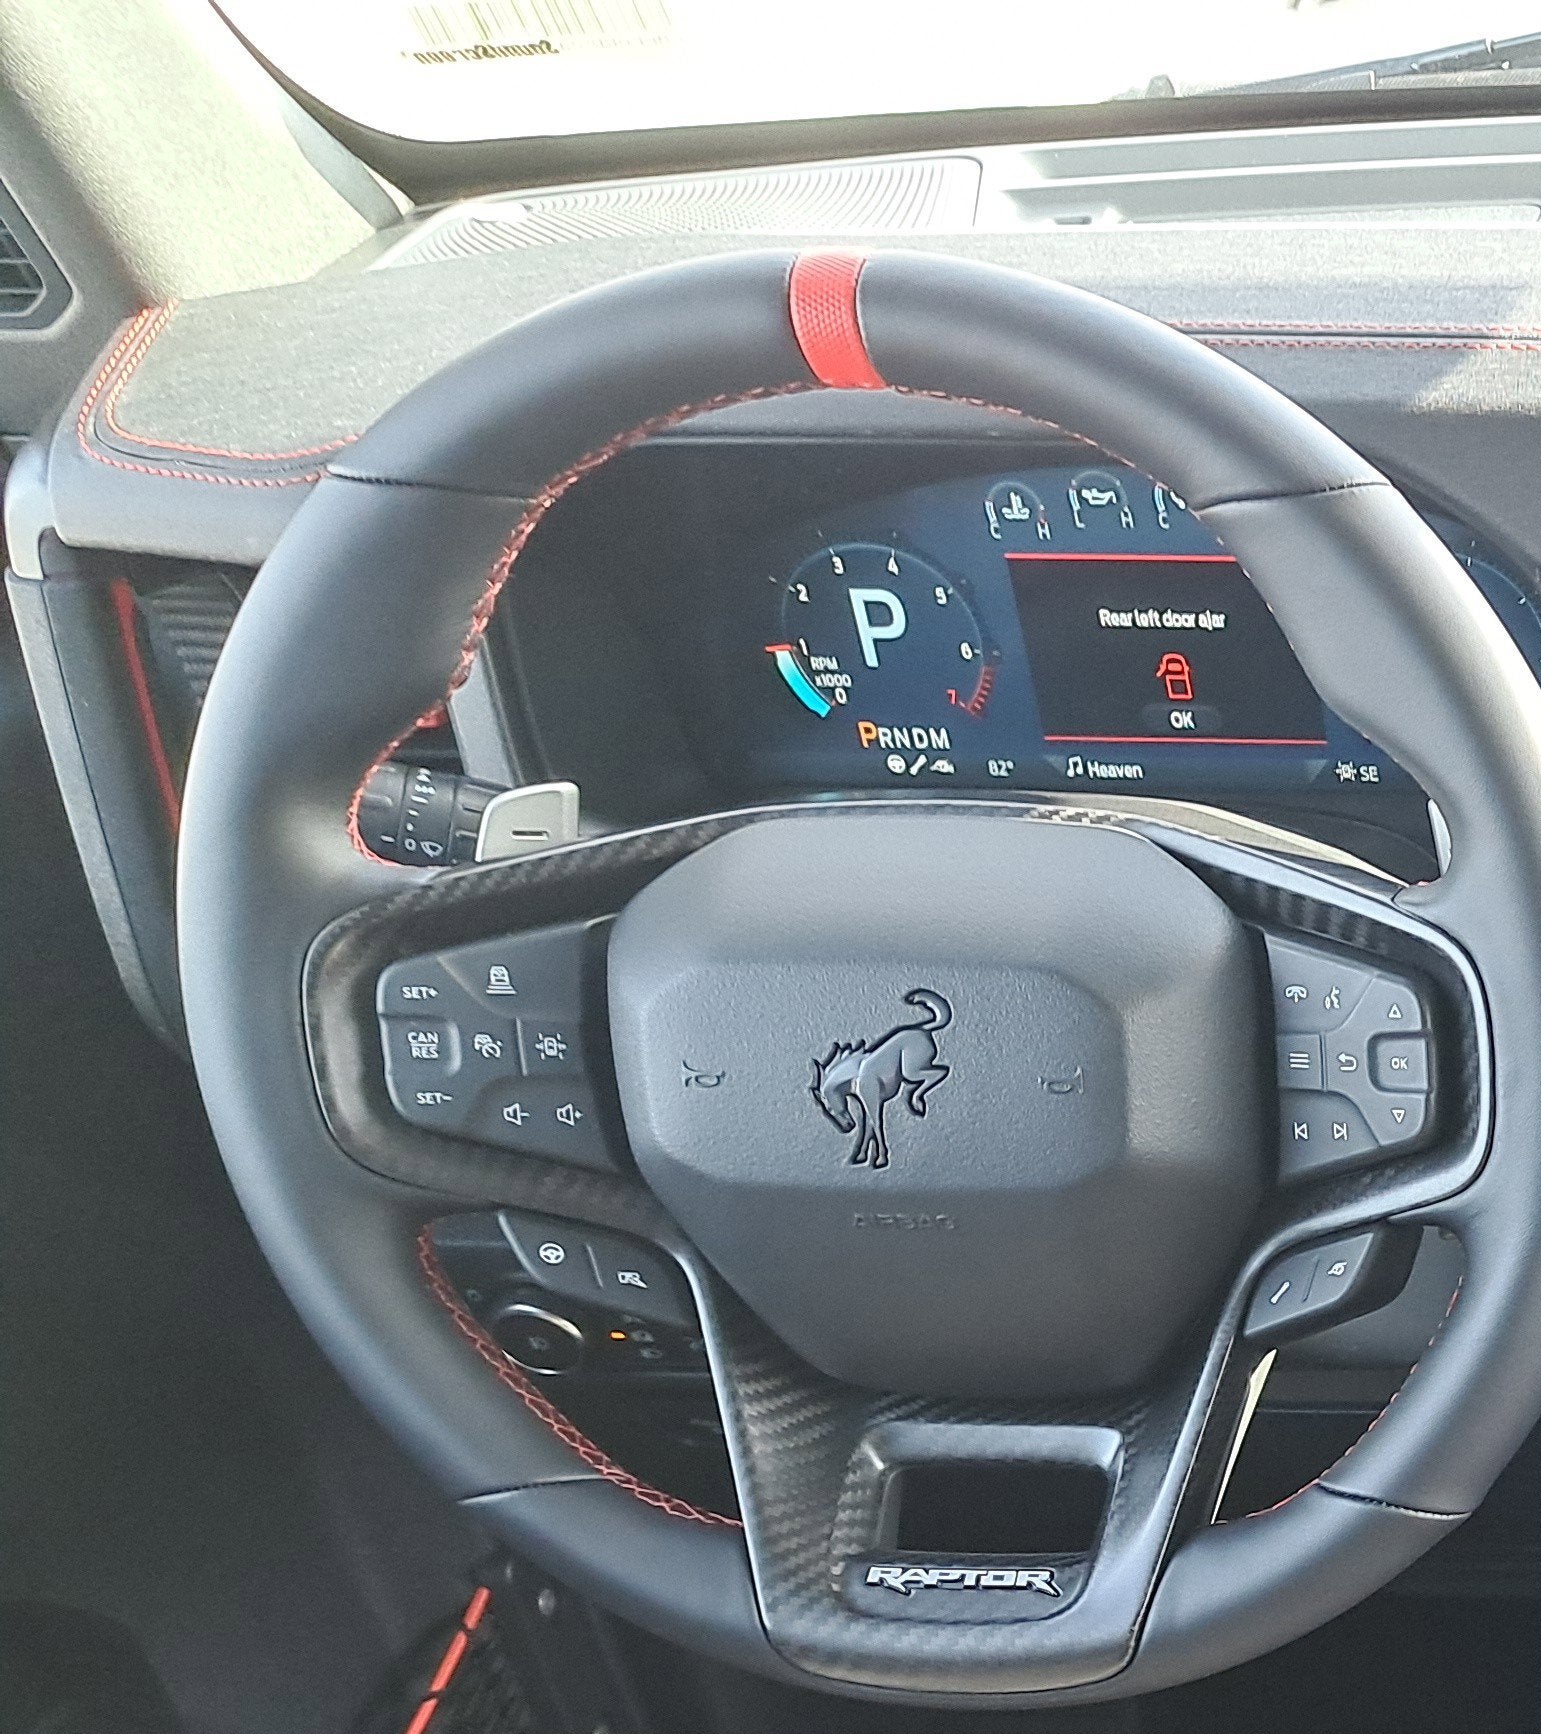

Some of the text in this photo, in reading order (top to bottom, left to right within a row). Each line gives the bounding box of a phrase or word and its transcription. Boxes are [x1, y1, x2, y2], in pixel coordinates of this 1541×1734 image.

[1119, 510, 1135, 530] H
[1036, 521, 1051, 541] H
[832, 558, 845, 575] 3
[886, 557, 899, 576] 4
[796, 584, 810, 602] 2
[848, 587, 907, 668] P
[1099, 608, 1226, 631] Rear left door ajar
[811, 656, 838, 671] RPM
[815, 673, 851, 688] x1000
[835, 688, 848, 704] 0
[1169, 710, 1195, 730] OK
[1086, 760, 1144, 780] Heaven
[1360, 765, 1380, 783] SE
[407, 1031, 440, 1044] CAN
[410, 1045, 440, 1059] RES
[1390, 1057, 1408, 1071] OK
[864, 1565, 1063, 1598] RAPTOR
